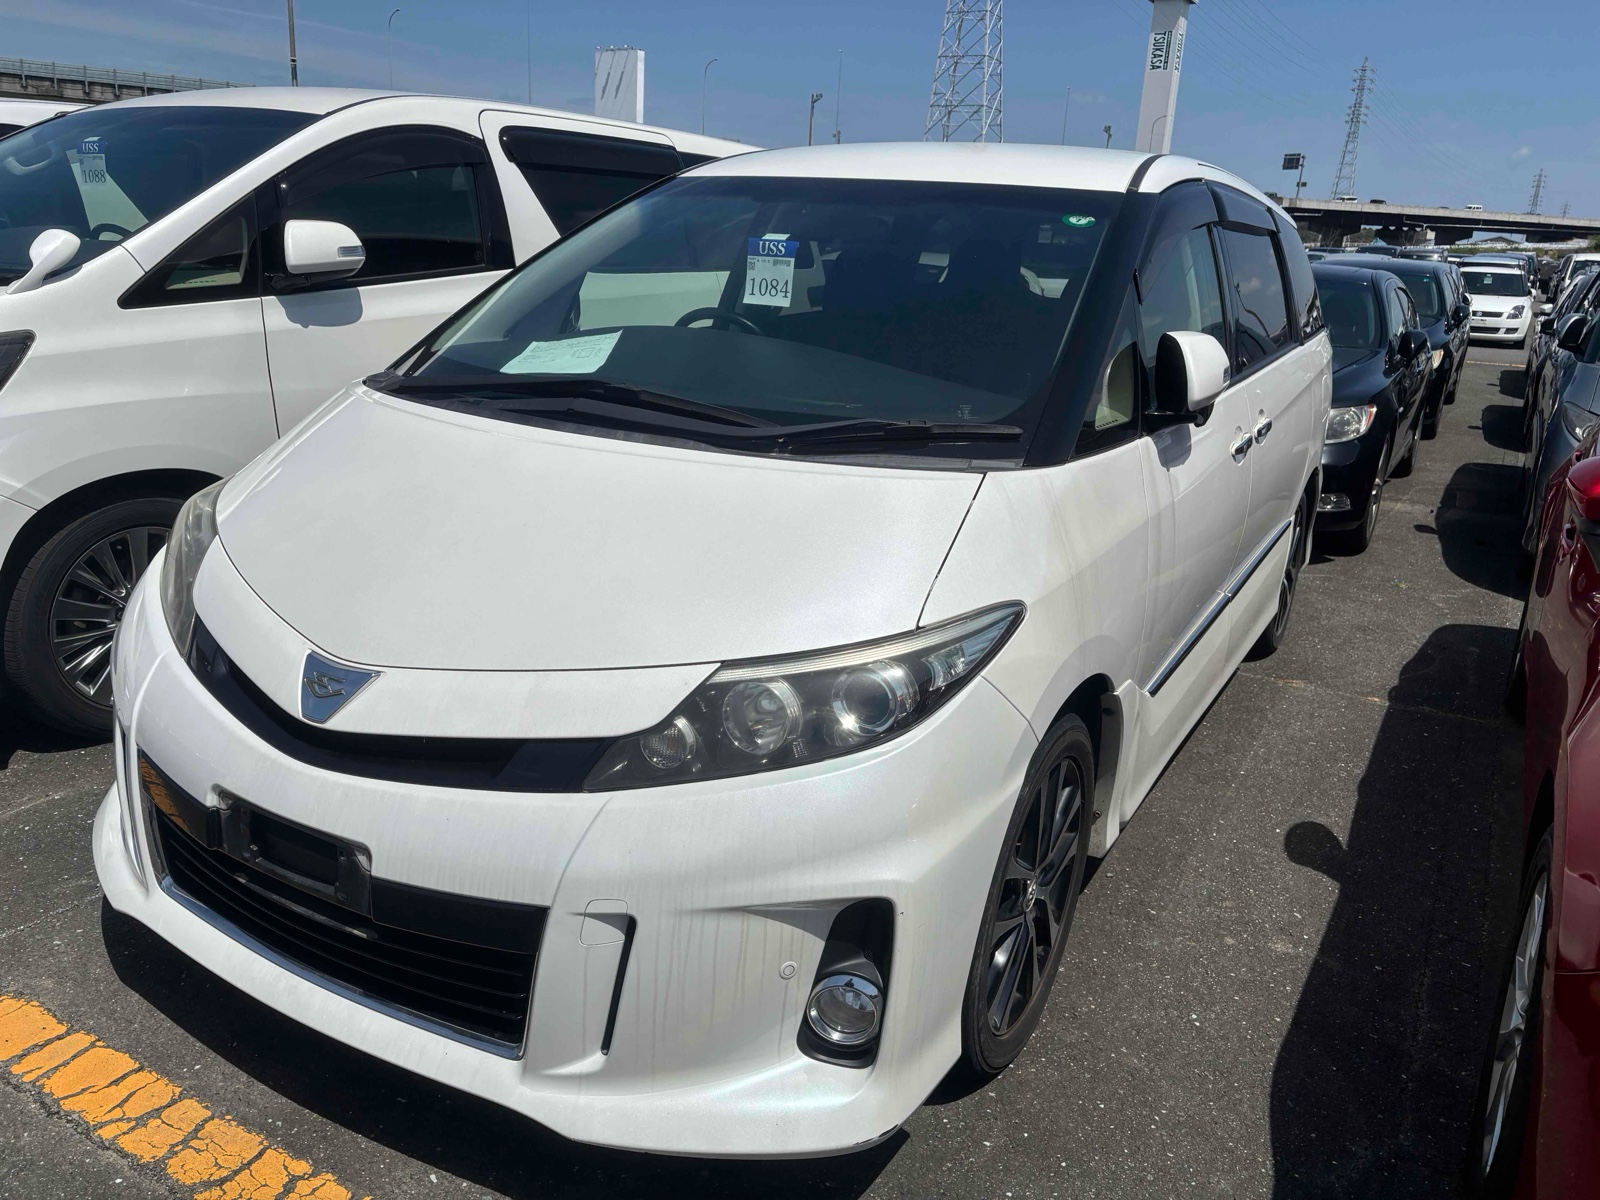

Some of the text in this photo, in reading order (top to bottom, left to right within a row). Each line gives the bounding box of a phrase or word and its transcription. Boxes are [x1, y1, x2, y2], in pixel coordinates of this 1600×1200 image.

[1149, 31, 1166, 70] TSUKASA
[1174, 32, 1184, 73] TSUKASA
[82, 142, 99, 153] USS
[82, 169, 107, 183] 1088
[759, 241, 786, 255] USS
[748, 277, 790, 299] 1084
